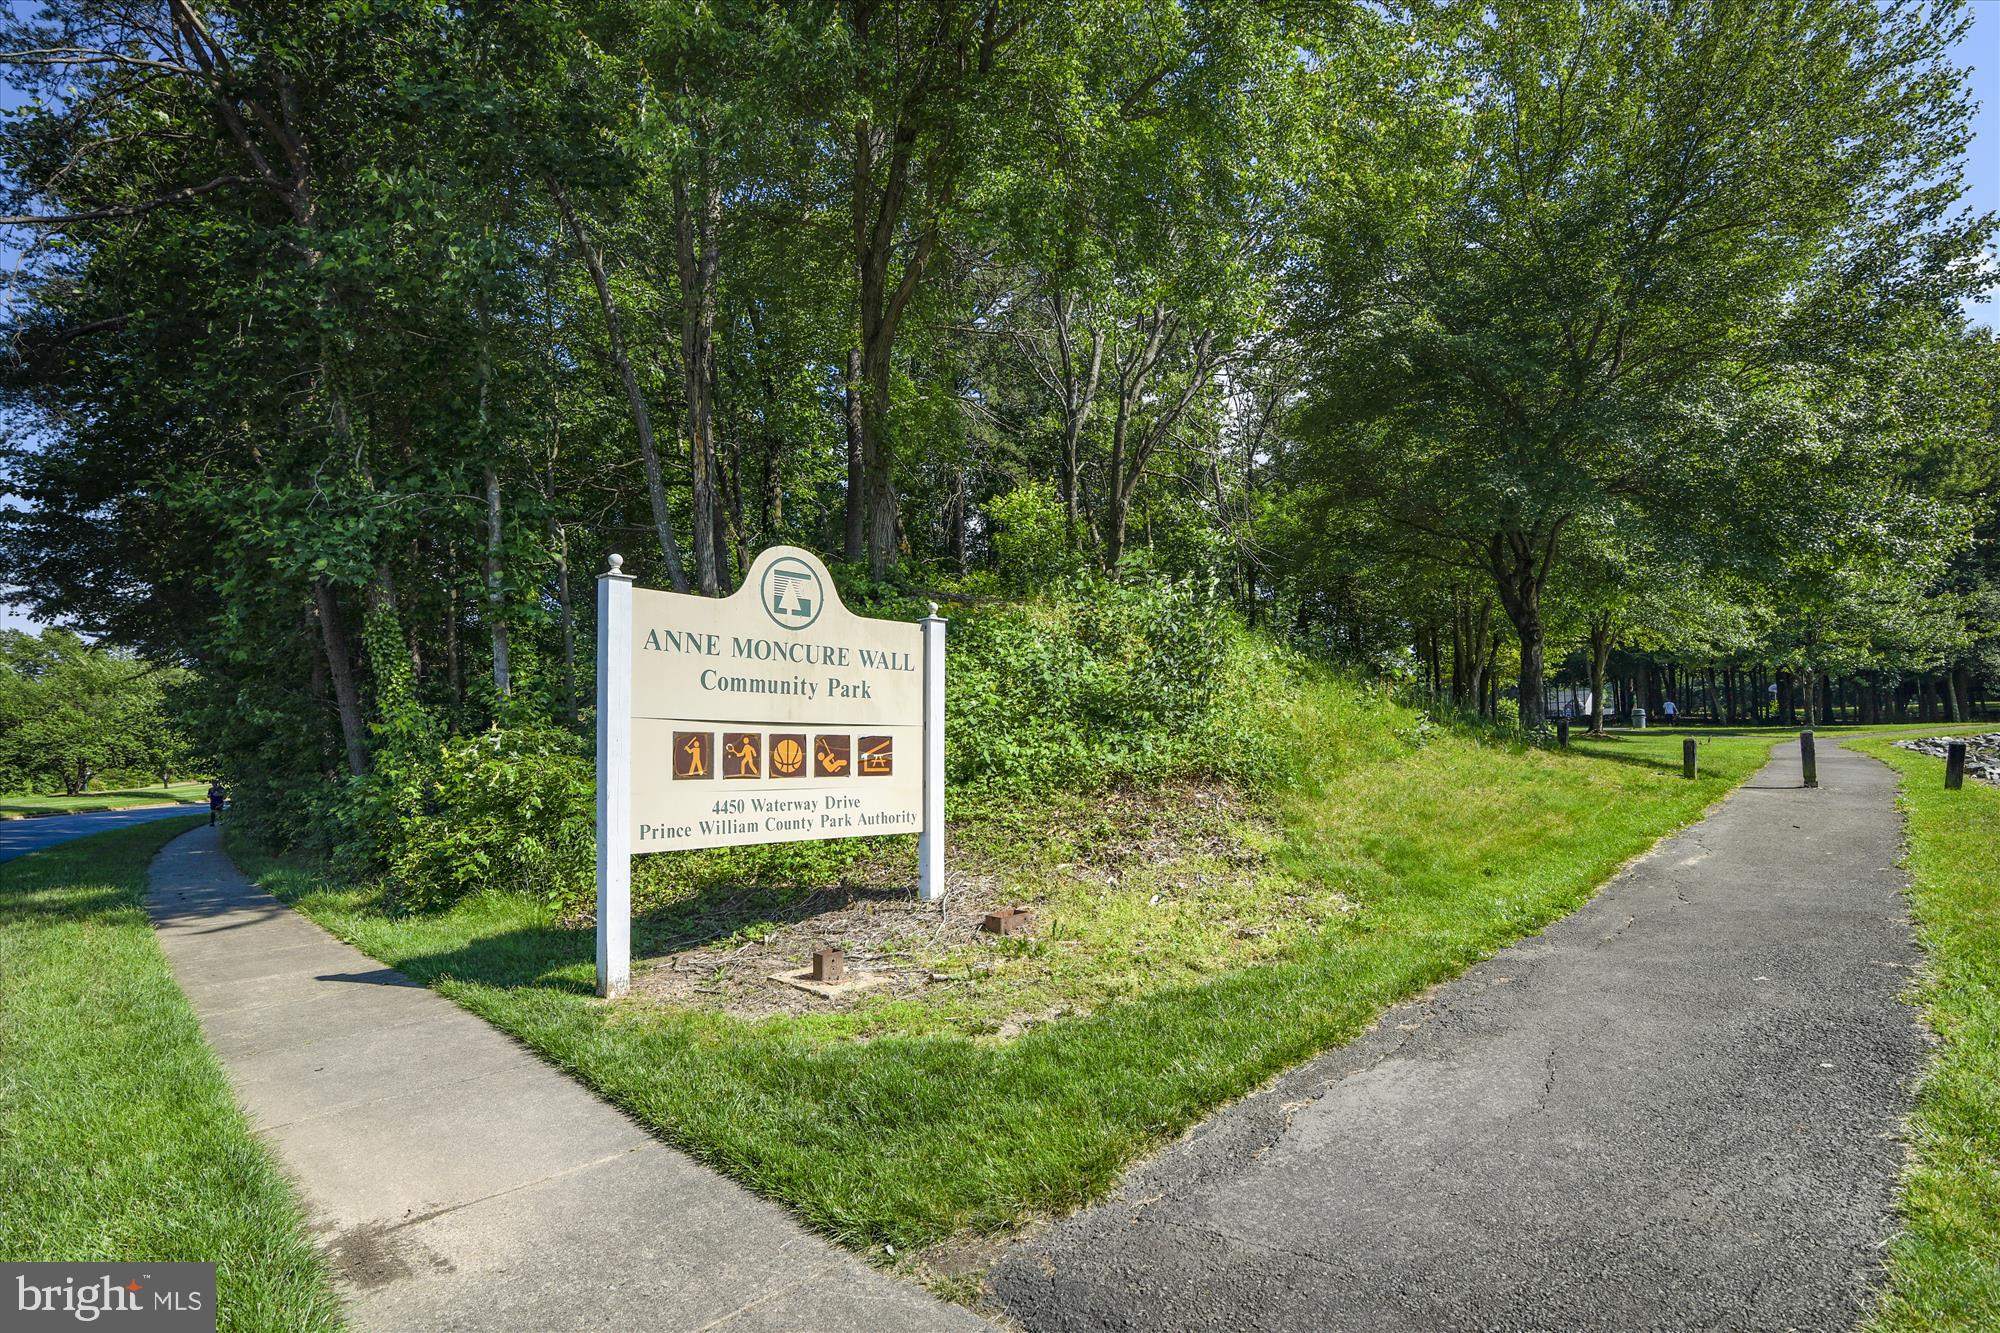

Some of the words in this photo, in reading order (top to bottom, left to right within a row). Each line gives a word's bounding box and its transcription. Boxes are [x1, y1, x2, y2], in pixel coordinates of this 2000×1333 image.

[643, 629, 720, 656] ANNE
[732, 637, 849, 667] MONCURE
[859, 650, 915, 672] WALL
[701, 670, 818, 700] Community
[829, 678, 871, 699] Park
[712, 799, 745, 815] 4450
[752, 798, 818, 813] Waterway
[825, 795, 861, 810] Drive
[640, 823, 692, 841] Prince
[699, 819, 760, 835] William
[765, 817, 814, 832] County
[821, 813, 852, 828] Park
[858, 811, 917, 825] Authority
